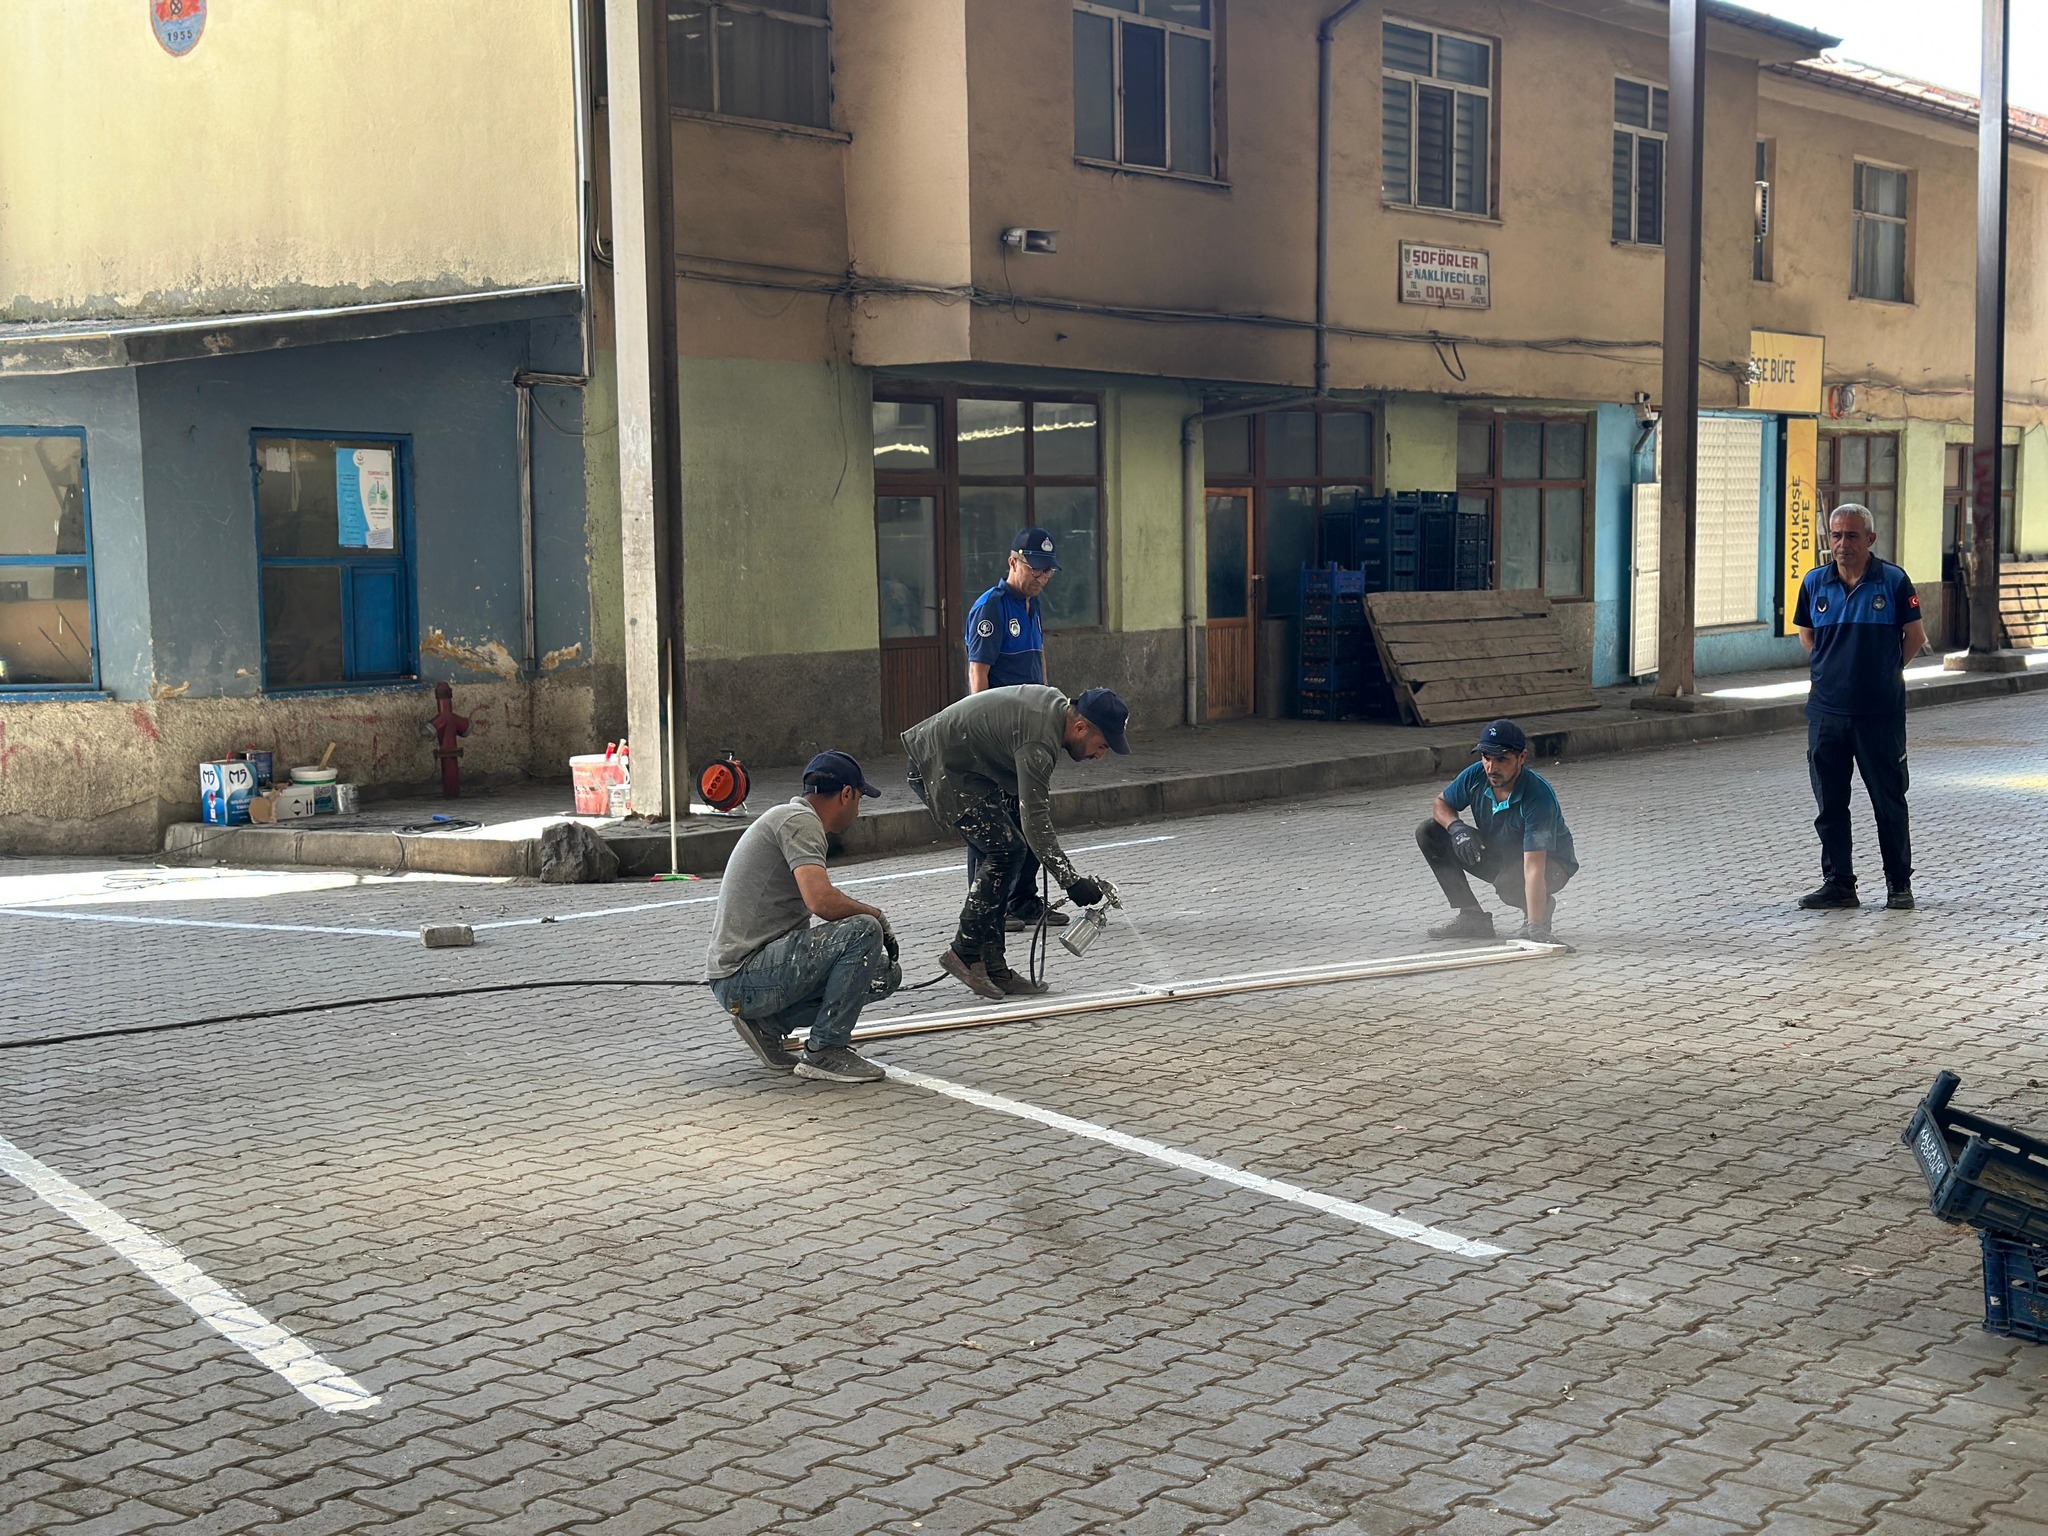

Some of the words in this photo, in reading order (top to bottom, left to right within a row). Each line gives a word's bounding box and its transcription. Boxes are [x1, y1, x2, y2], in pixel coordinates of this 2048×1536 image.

[167, 30, 192, 41] 1955
[1413, 249, 1478, 269] ŞOFÖRLER
[1414, 268, 1486, 286] NAKLİYECİLER
[1426, 286, 1464, 300] ODASI
[1770, 353, 1796, 384] BÜFE
[1790, 475, 1802, 525] KÖŞE
[1800, 499, 1810, 550] BÜFE
[1790, 532, 1800, 579] MAVİ
[229, 768, 247, 784] M5
